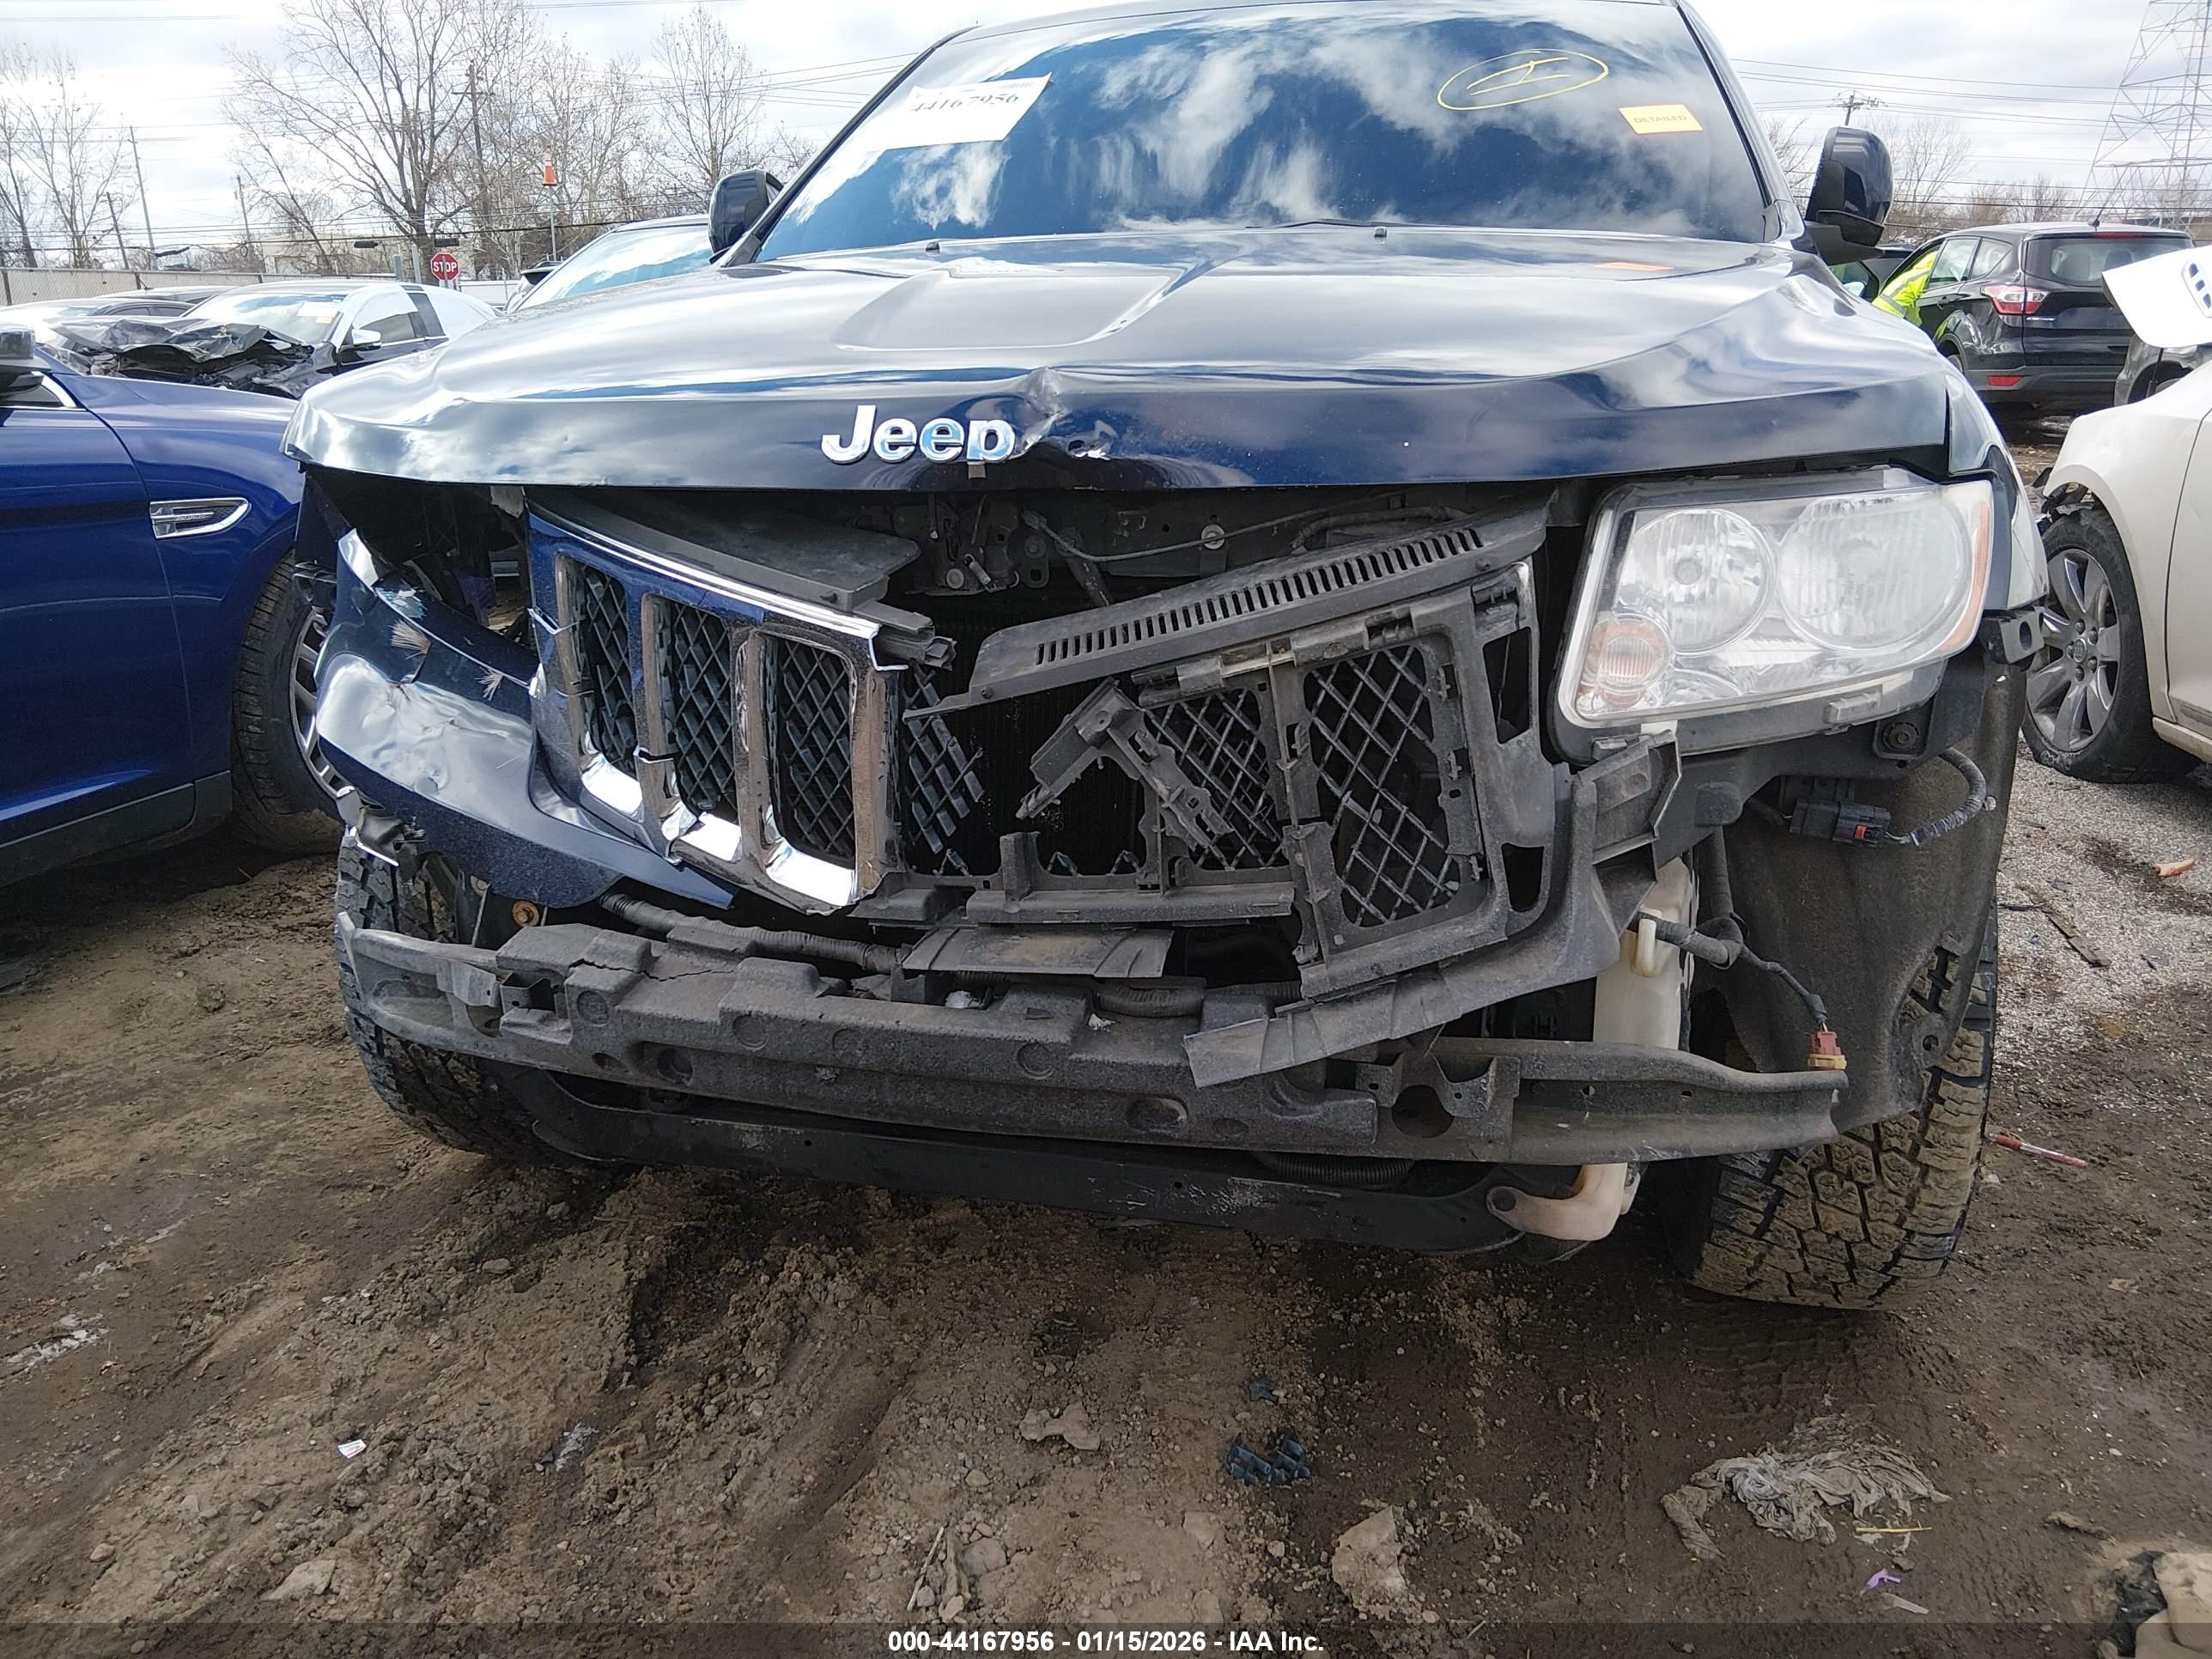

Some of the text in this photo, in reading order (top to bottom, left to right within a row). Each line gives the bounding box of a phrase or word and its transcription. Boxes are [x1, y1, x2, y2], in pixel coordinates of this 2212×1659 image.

[1633, 114, 1687, 124] DETAILED
[433, 261, 457, 273] STOP
[821, 404, 1016, 478] Jeep
